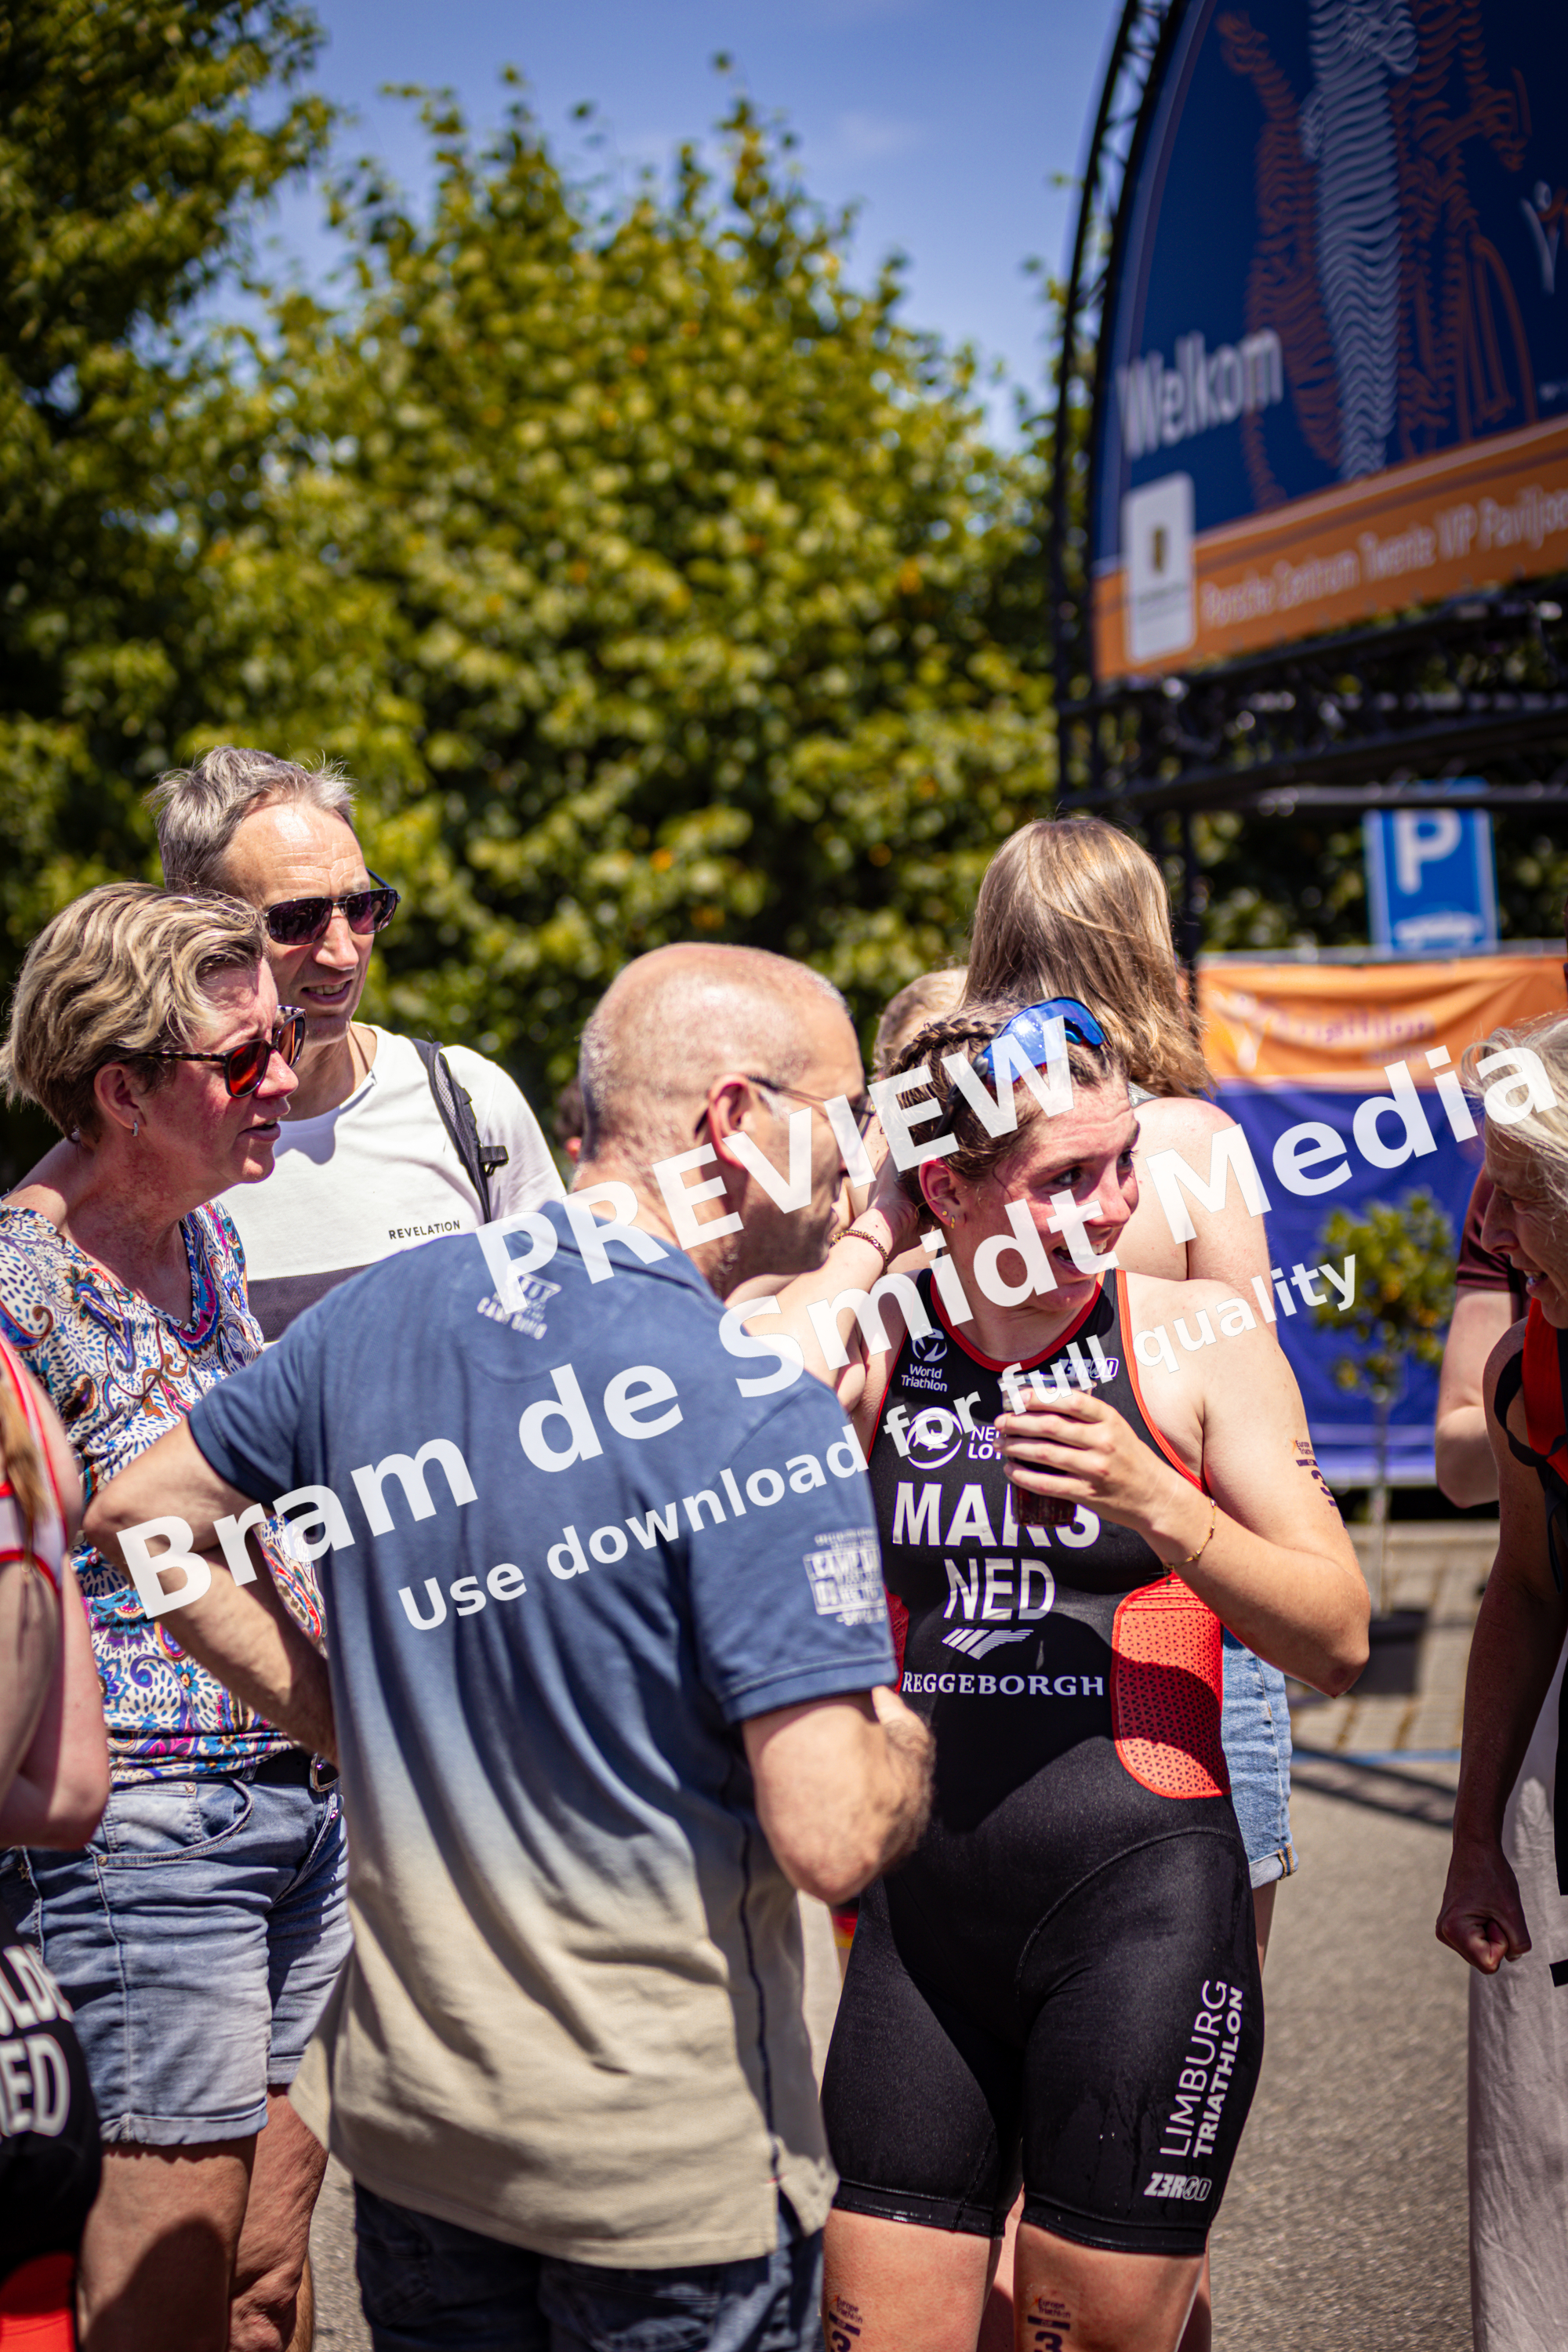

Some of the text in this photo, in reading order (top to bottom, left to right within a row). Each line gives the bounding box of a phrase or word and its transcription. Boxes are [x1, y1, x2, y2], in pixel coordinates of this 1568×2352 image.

[1116, 329, 1283, 459] Welkom
[1392, 808, 1462, 895] P
[388, 1220, 460, 1240] REVELATION
[902, 1374, 948, 1392] Triathlon
[909, 1363, 942, 1379] World
[943, 1557, 1055, 1620] NED
[902, 1671, 1104, 1696] REGGEBORGH
[0, 2033, 71, 2138] ED
[1160, 1980, 1228, 2156] LIMBURG
[1192, 1986, 1243, 2158] TRIATHLON
